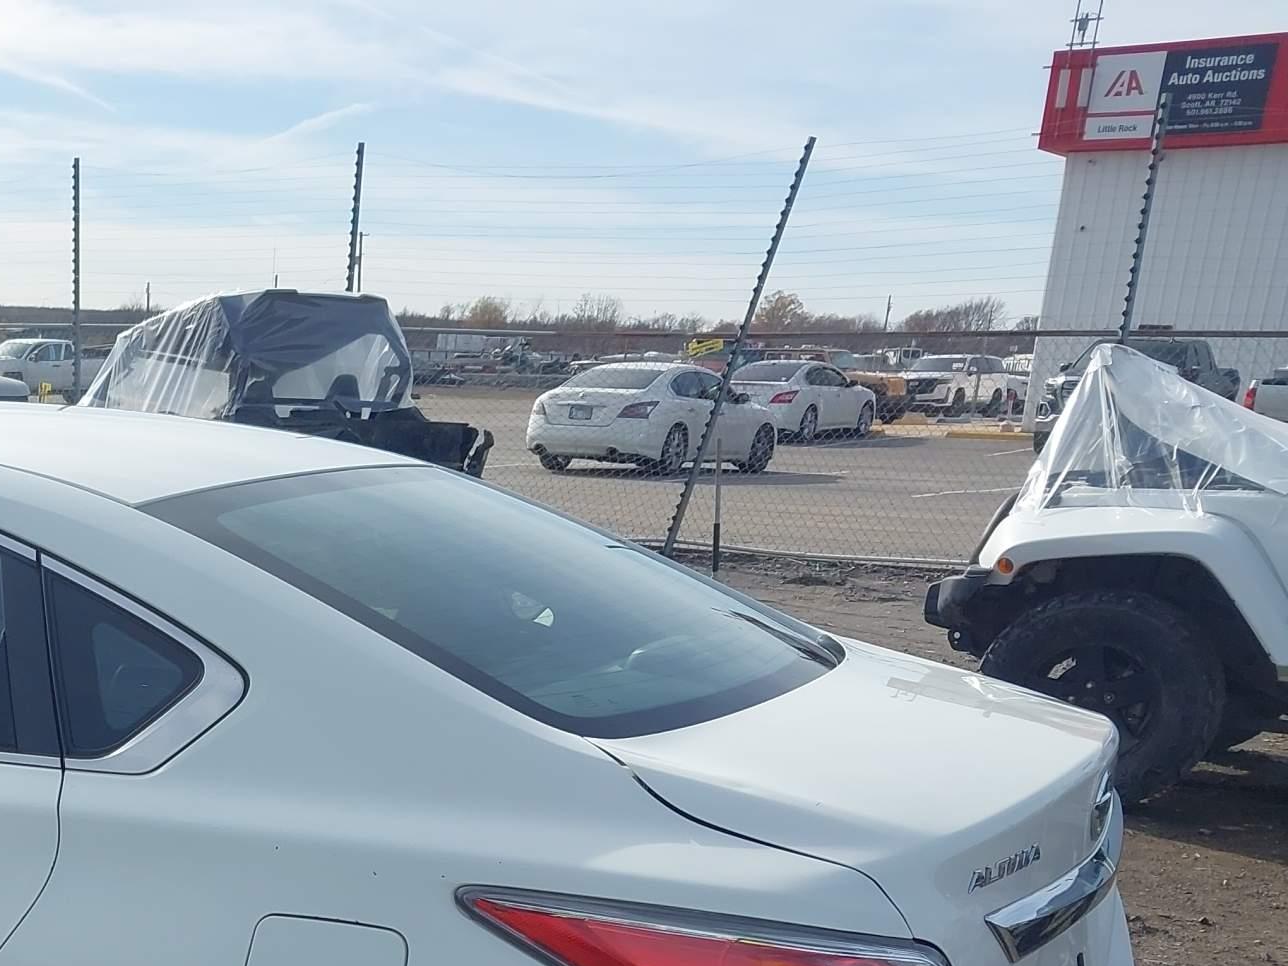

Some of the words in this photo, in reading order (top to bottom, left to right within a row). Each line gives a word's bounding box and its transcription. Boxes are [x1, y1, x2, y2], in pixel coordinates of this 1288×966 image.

[1185, 53, 1255, 69] Insurance
[1167, 72, 1200, 86] Auto
[1202, 67, 1266, 83] Auctions
[1097, 125, 1117, 134] Little
[1118, 124, 1137, 133] Rock
